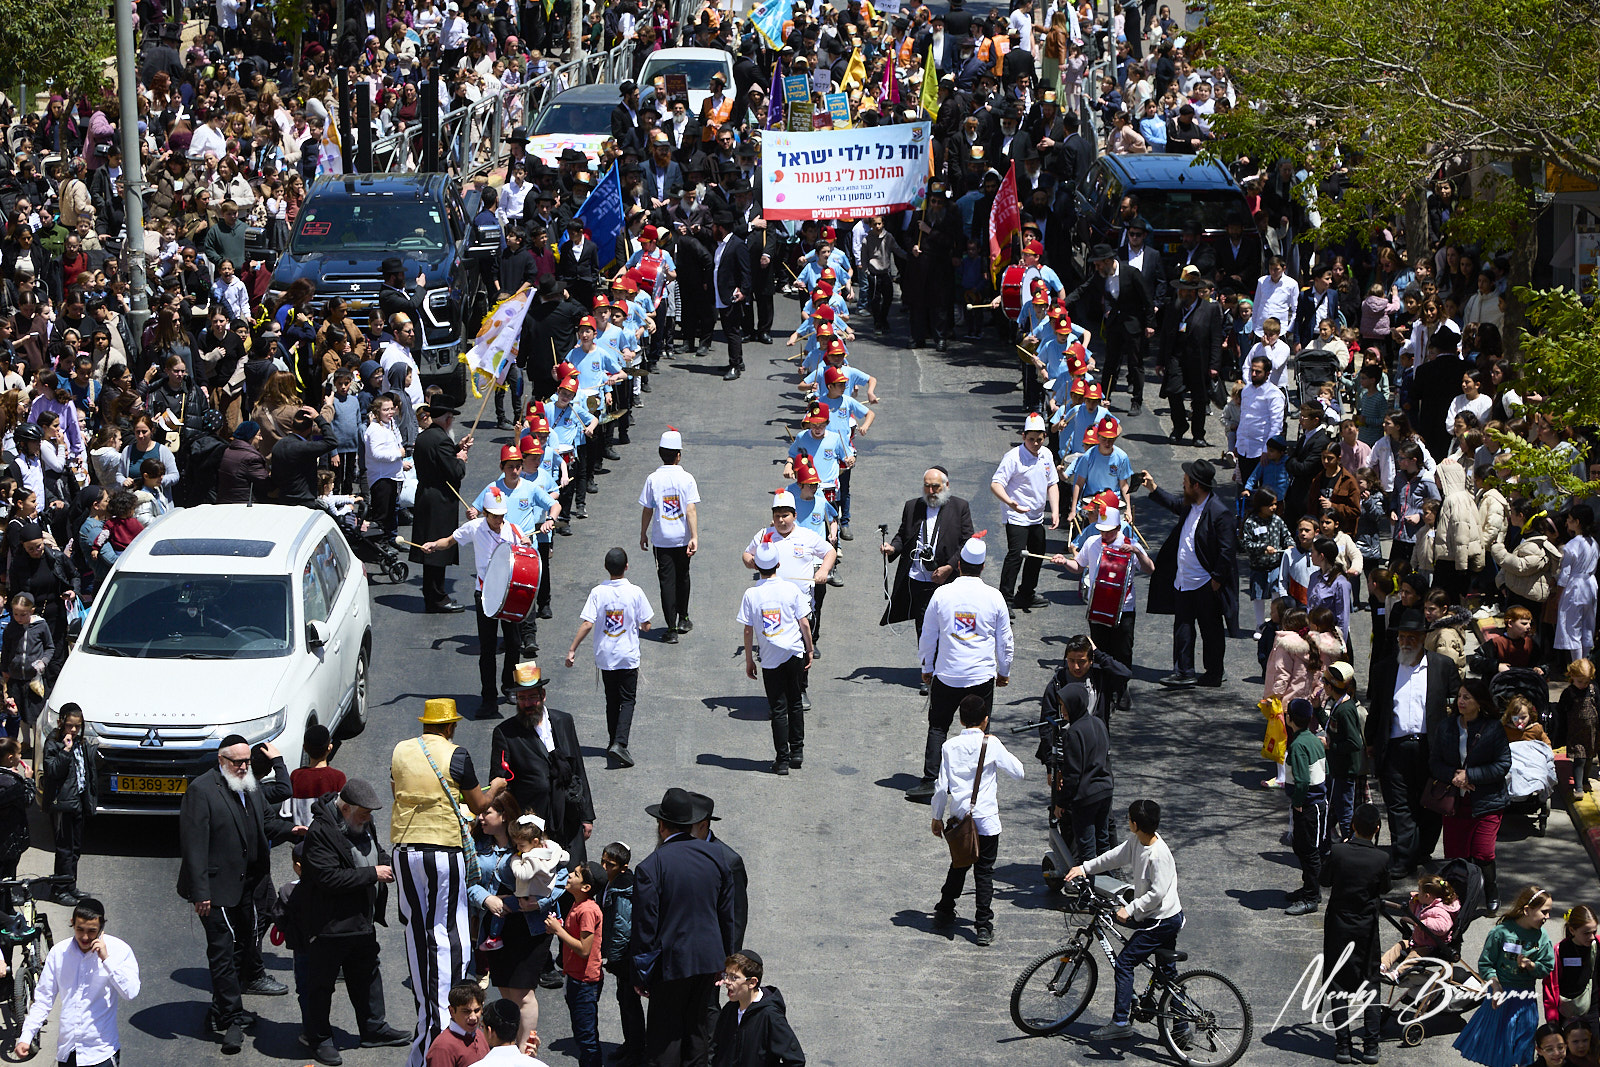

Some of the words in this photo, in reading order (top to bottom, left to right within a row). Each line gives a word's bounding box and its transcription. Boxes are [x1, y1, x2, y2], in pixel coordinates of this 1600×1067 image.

[838, 144, 870, 161] ילדי
[874, 142, 894, 160] כל
[898, 144, 924, 160] יחד
[777, 148, 833, 168] ישראל
[794, 168, 832, 184] בעומר
[859, 165, 904, 182] תהלוכת
[816, 194, 836, 202] יוחאי
[848, 192, 872, 202] שמעון
[873, 191, 885, 199] רבי
[811, 209, 843, 219] ירושלים
[849, 207, 874, 217] שלמה
[874, 206, 891, 215] רמת
